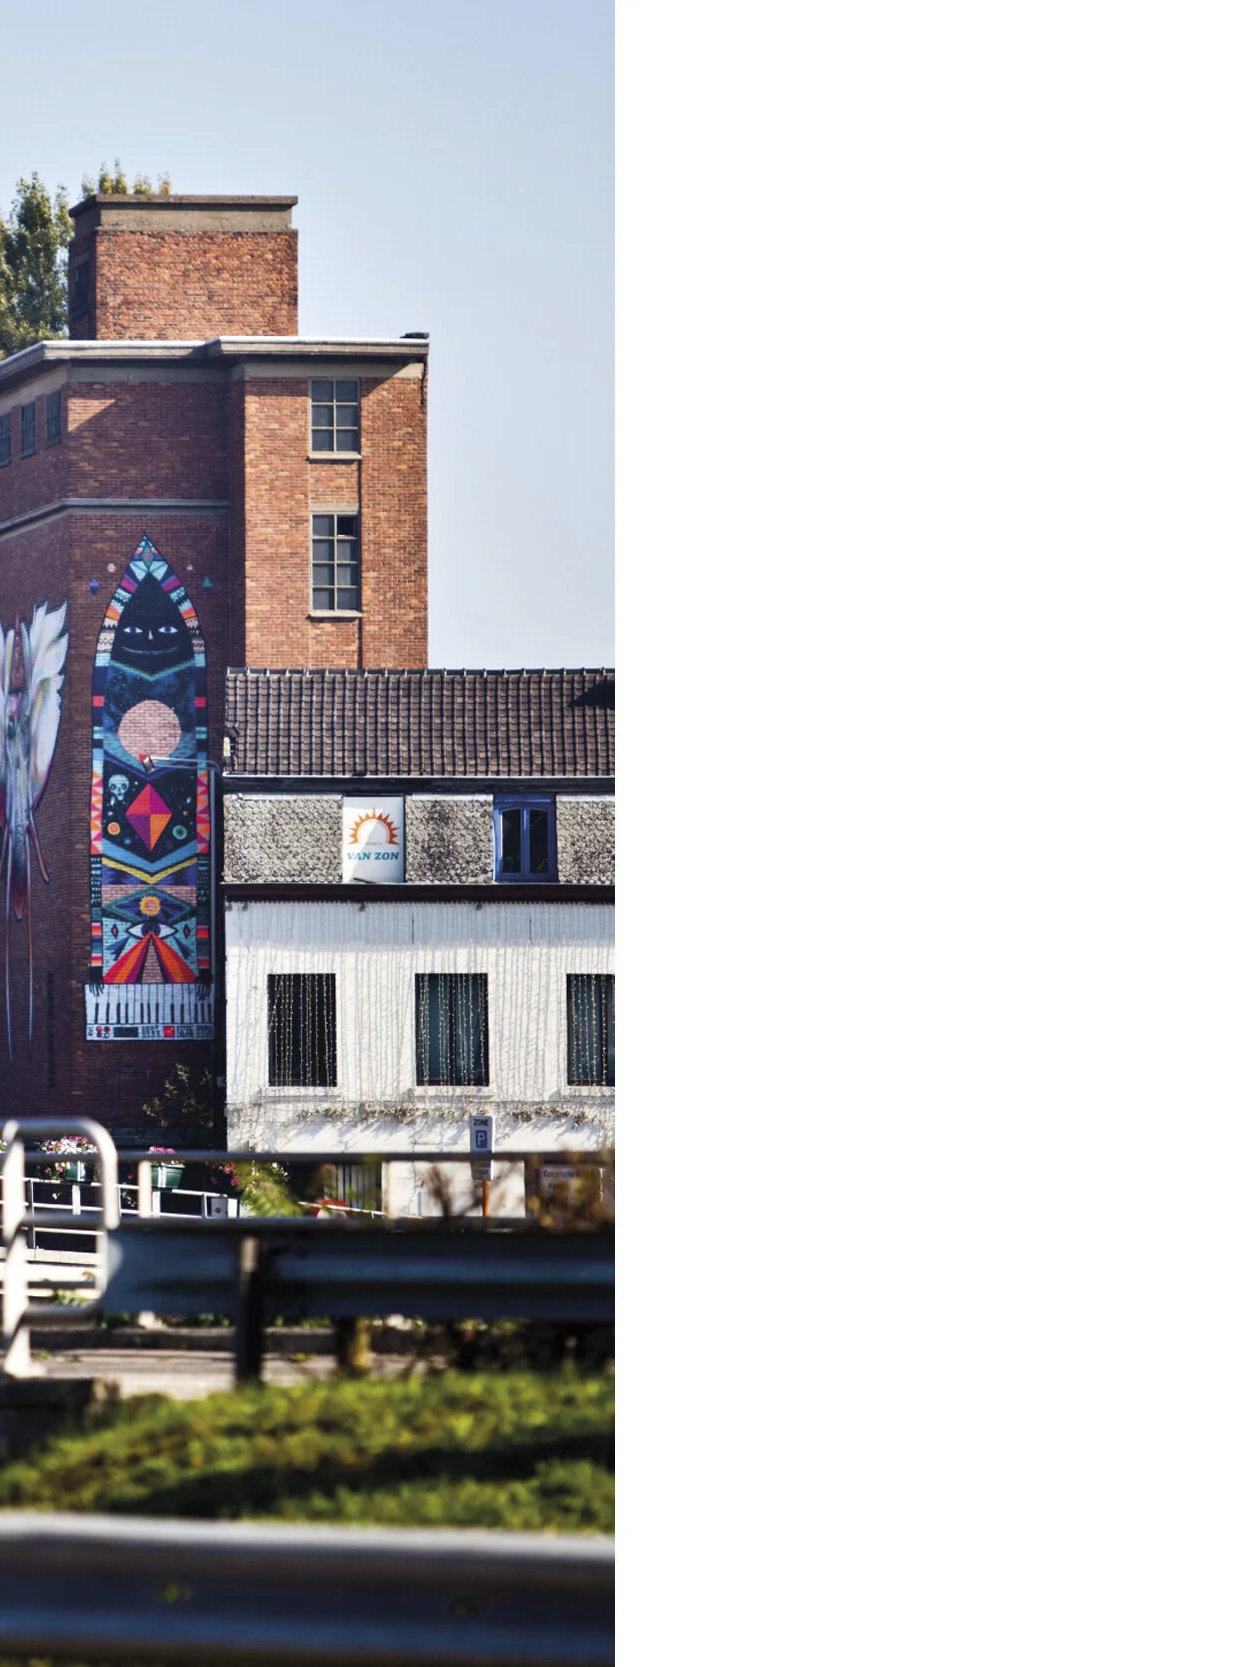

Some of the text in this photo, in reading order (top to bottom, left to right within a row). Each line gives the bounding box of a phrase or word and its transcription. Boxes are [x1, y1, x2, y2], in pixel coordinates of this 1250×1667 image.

[347, 852, 399, 861] VAN ZON
[477, 1132, 485, 1146] P
